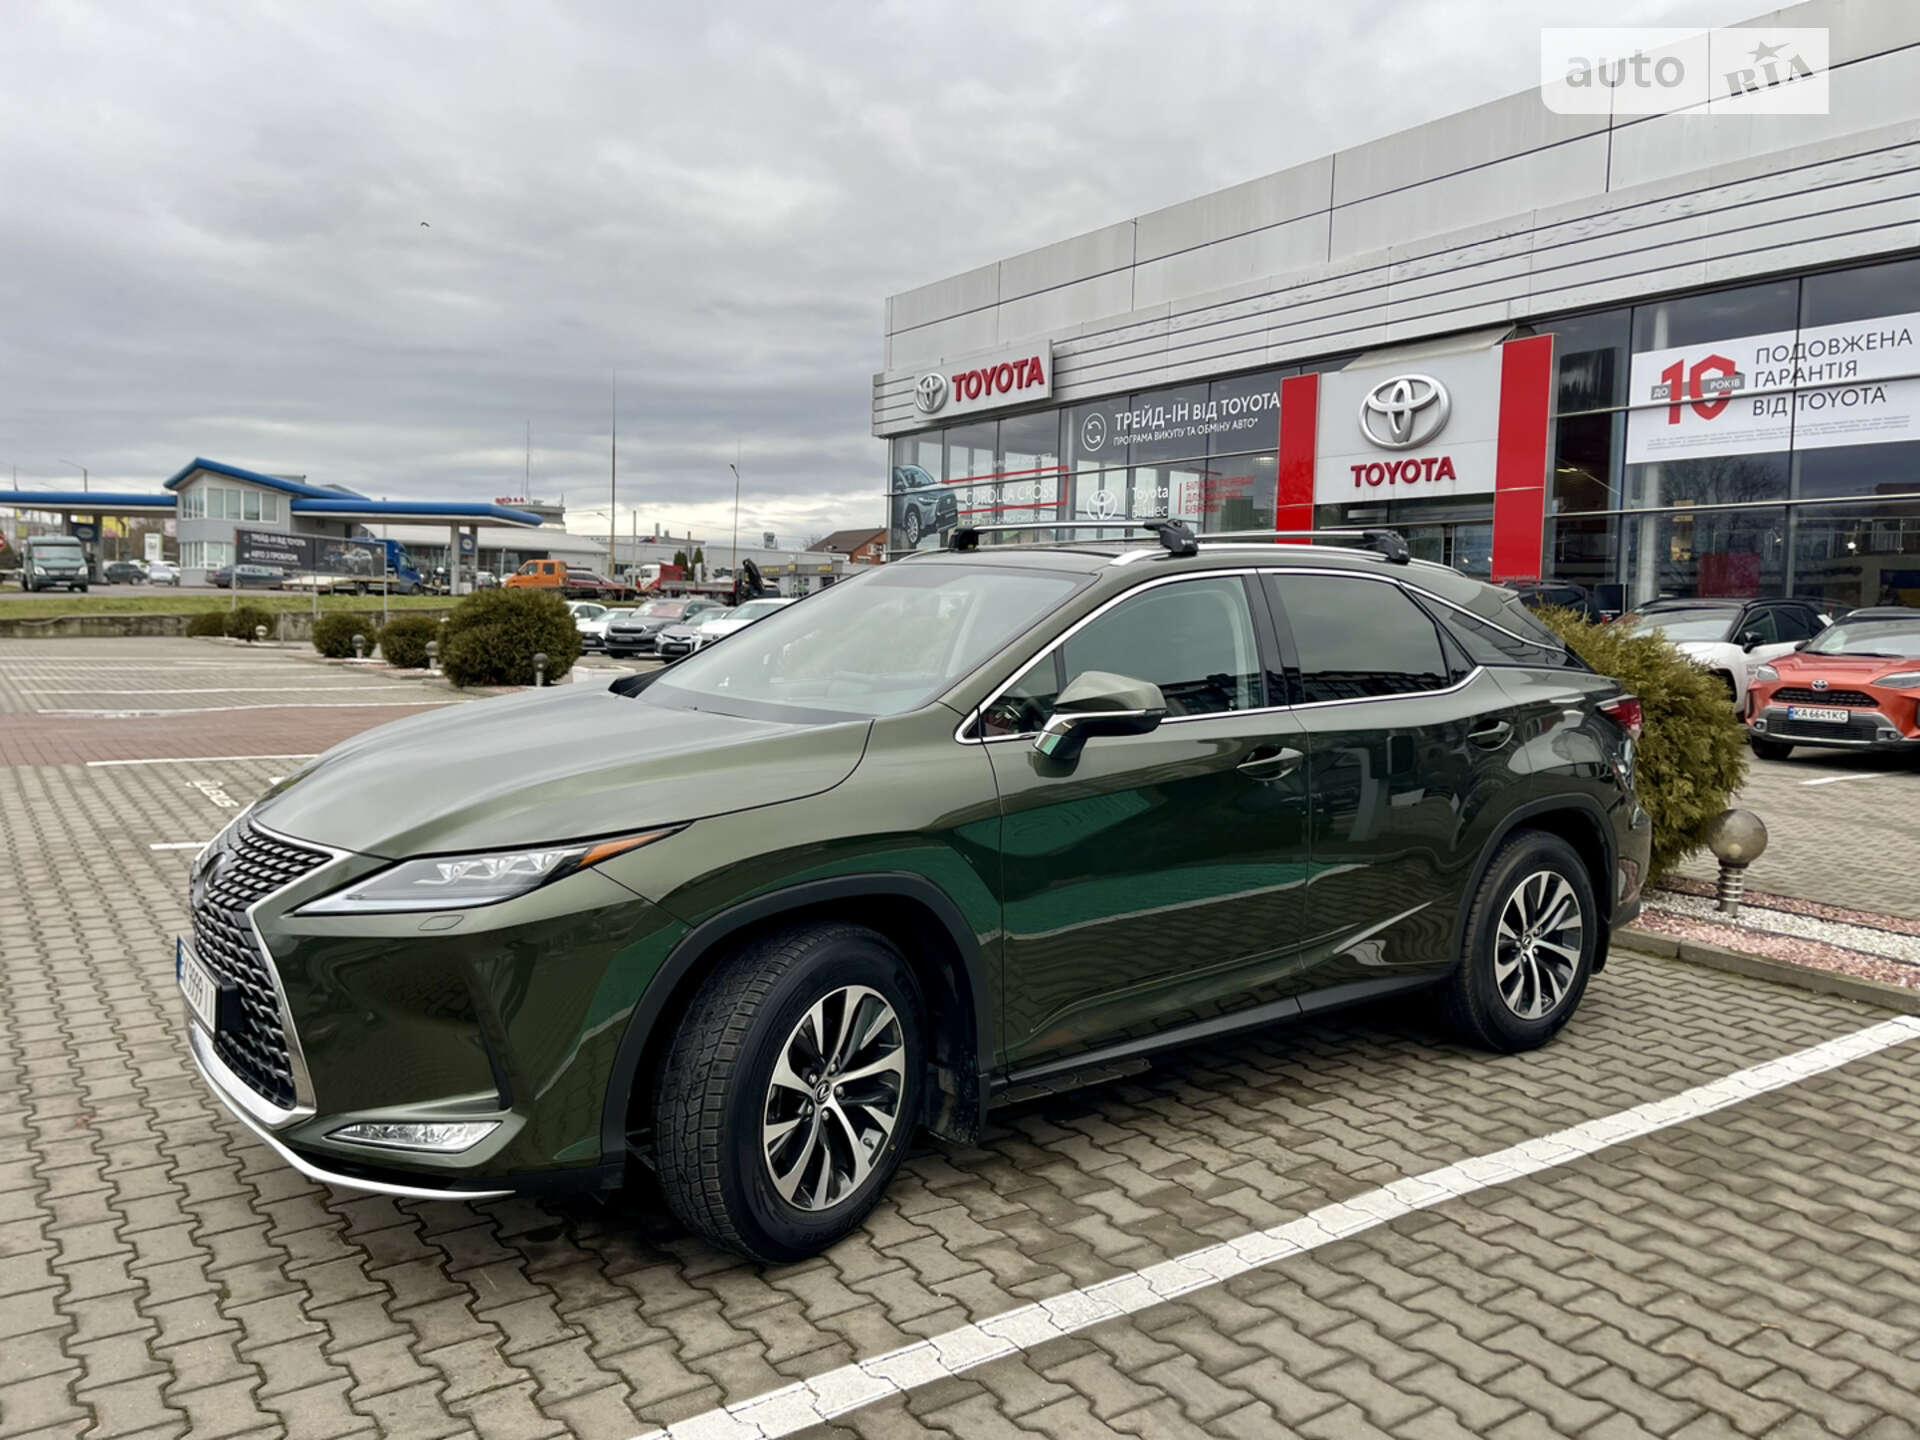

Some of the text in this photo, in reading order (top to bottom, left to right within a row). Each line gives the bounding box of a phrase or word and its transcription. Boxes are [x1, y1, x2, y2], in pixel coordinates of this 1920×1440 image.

[1755, 328, 1913, 365] ПОДОВЖЕНА
[951, 356, 1045, 402] TOYOTA
[1754, 360, 1857, 388] ГАРАНТІЯ
[1653, 354, 1741, 425] ДО 10 РОКІВ
[1115, 392, 1281, 431] ТРЕЙД-ІН ВІД TOYOTA
[1752, 396, 1787, 418] ВІД
[1113, 434, 1153, 447] ПРОГРАМА
[1154, 427, 1185, 441] ВИКУПУ
[1186, 426, 1196, 436] ТА
[1197, 421, 1230, 435] ОБМІНУ
[1350, 456, 1456, 488] TOYOTA
[1017, 484, 1057, 500] CROSS
[1132, 486, 1168, 504] Toyota
